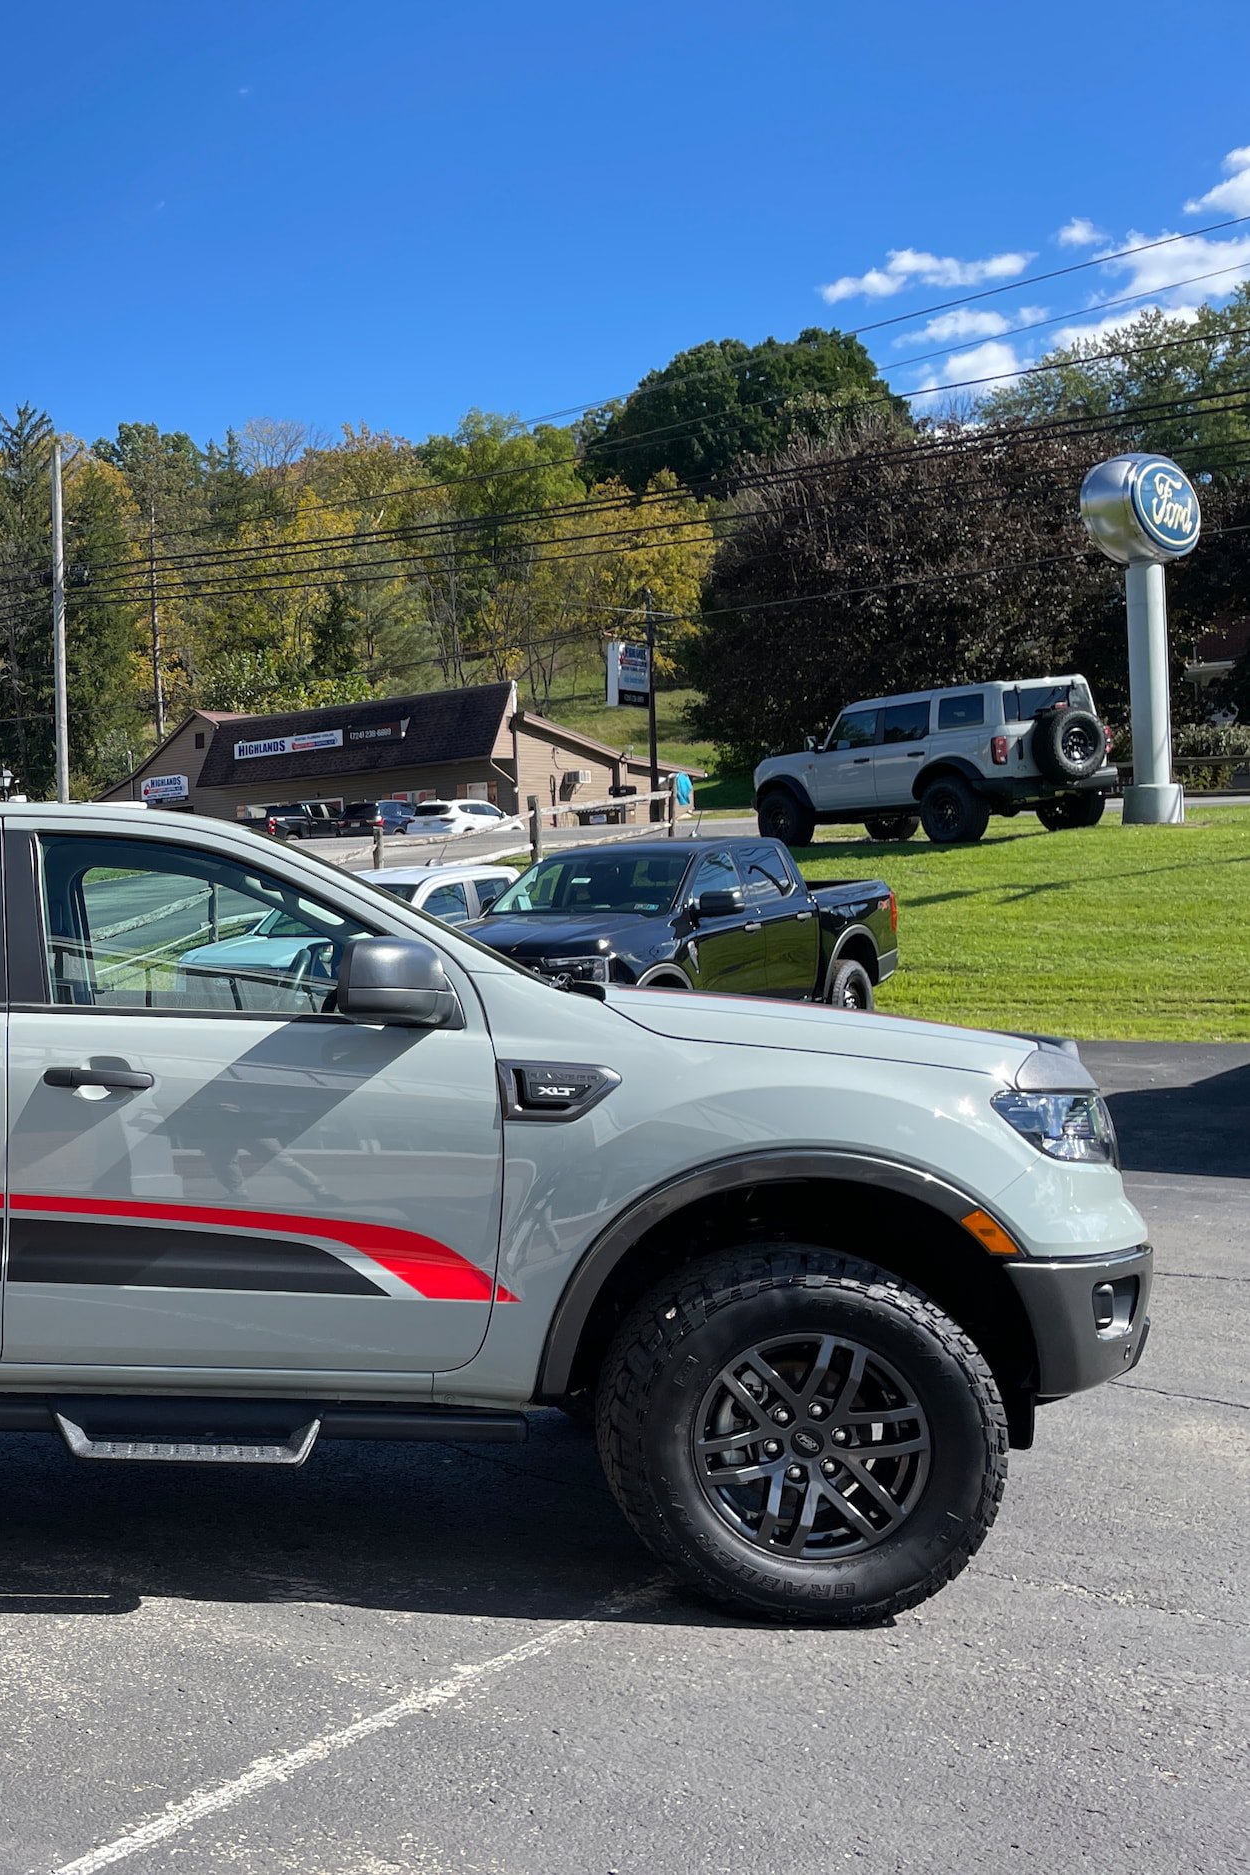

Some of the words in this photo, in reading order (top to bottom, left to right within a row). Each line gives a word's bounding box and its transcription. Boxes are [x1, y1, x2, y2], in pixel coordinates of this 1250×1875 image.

[1152, 472, 1192, 534] Ford
[238, 739, 286, 757] HIGHLANDS
[150, 776, 181, 788] HIGHLANDS
[538, 1086, 576, 1097] XLT
[694, 1532, 858, 1601] GRABBER
